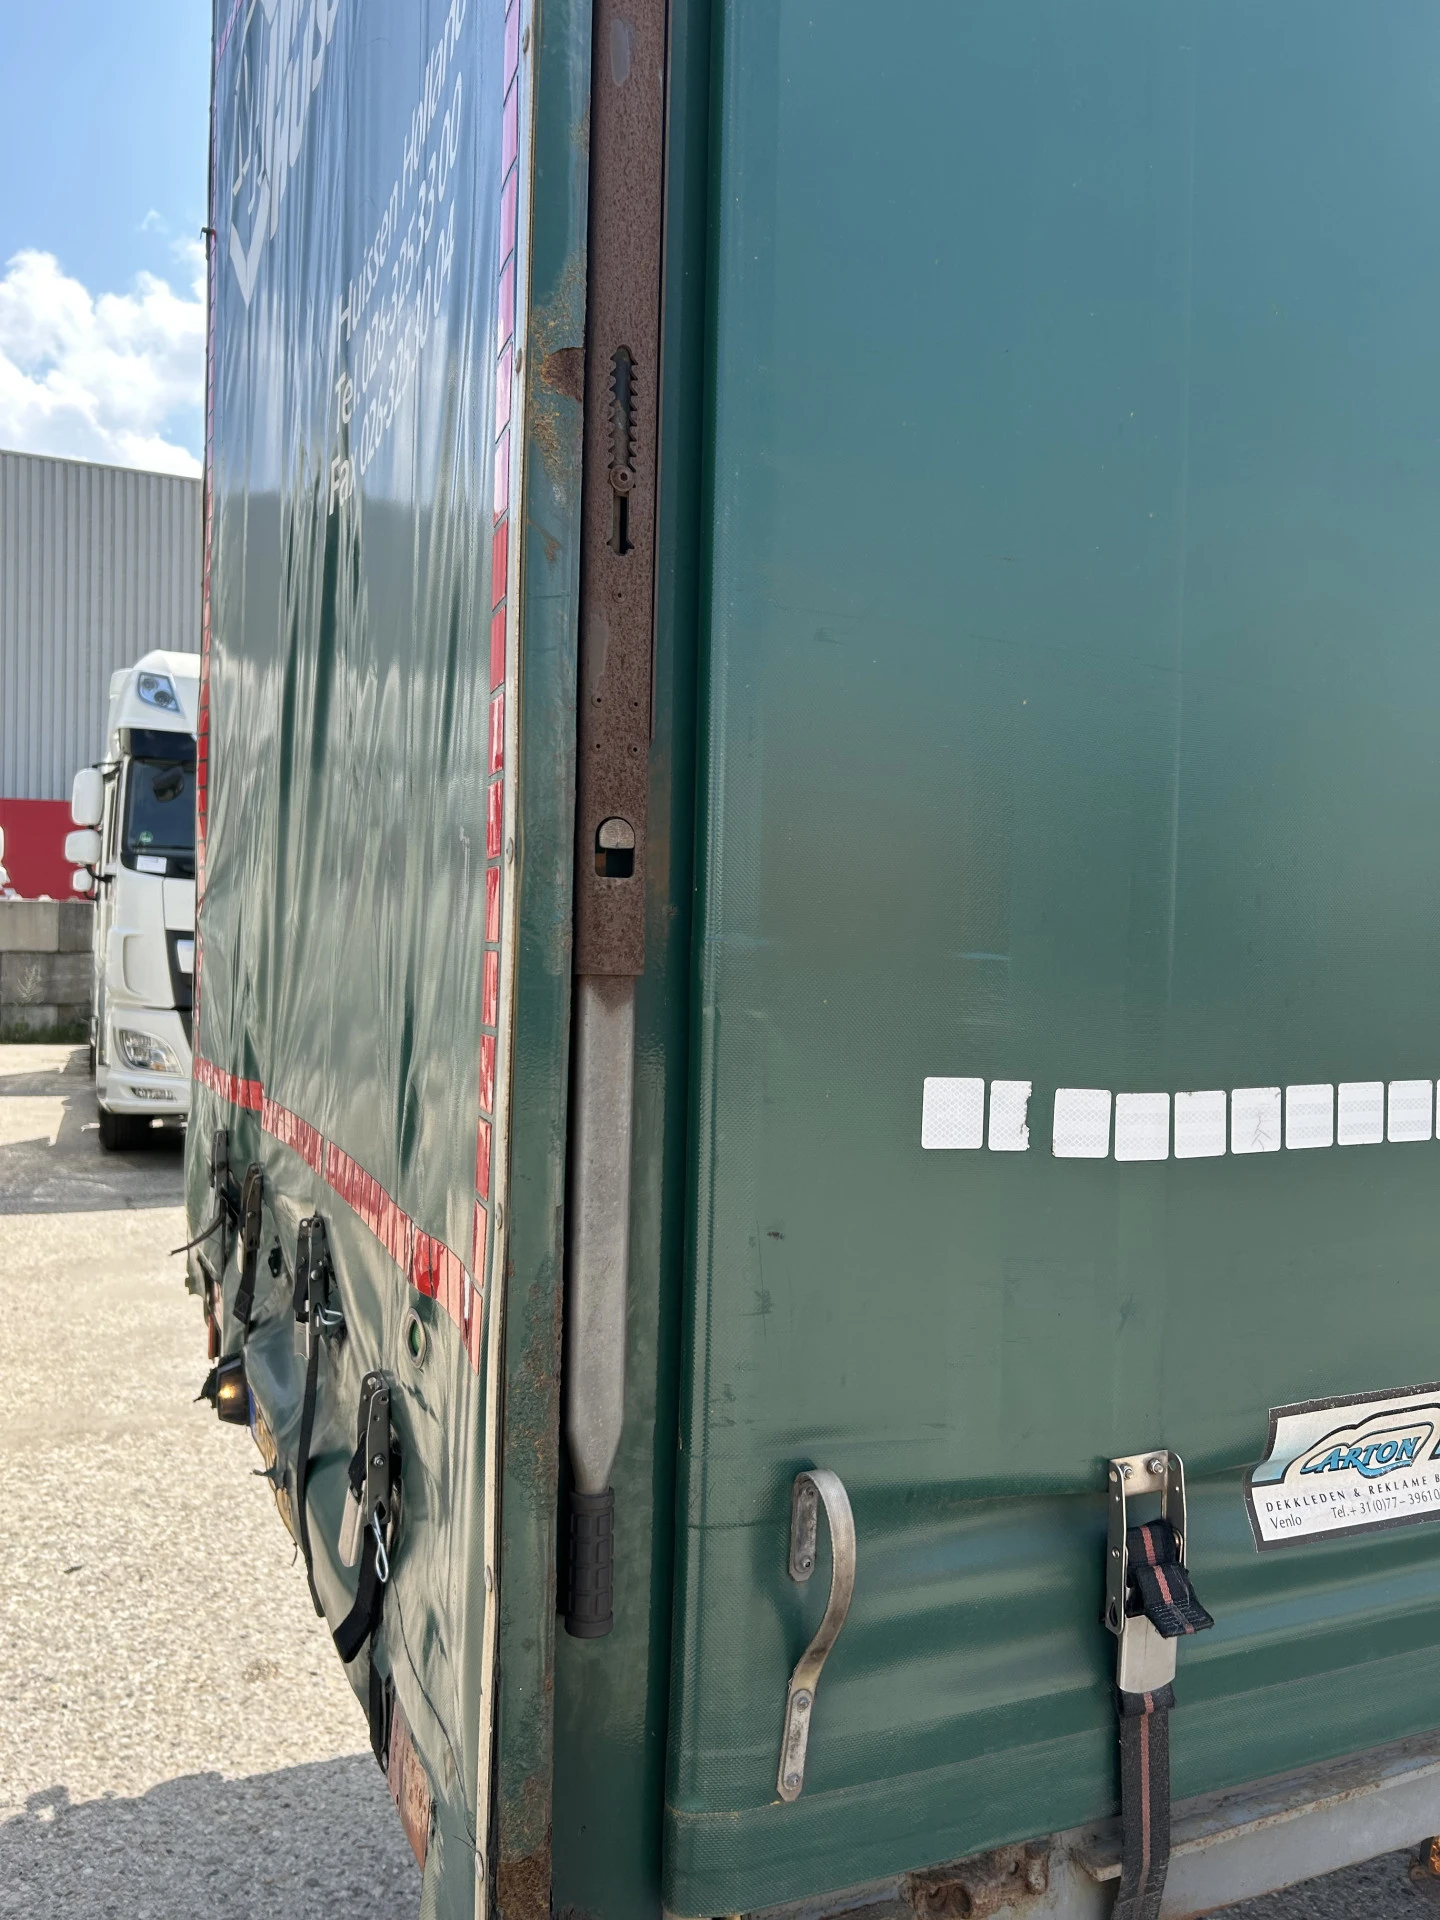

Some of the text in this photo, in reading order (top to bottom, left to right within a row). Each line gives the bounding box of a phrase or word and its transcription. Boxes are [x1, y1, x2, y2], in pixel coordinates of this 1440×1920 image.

[338, 179, 398, 354] Huissen
[335, 371, 360, 434] Tel.
[329, 453, 357, 516] Fax
[1300, 1436, 1422, 1479] ARTON
[1266, 1490, 1346, 1512] DEKKLEDEN
[1353, 1488, 1361, 1497] &
[1368, 1476, 1427, 1495] REKLAME
[1270, 1514, 1302, 1530] Venlo
